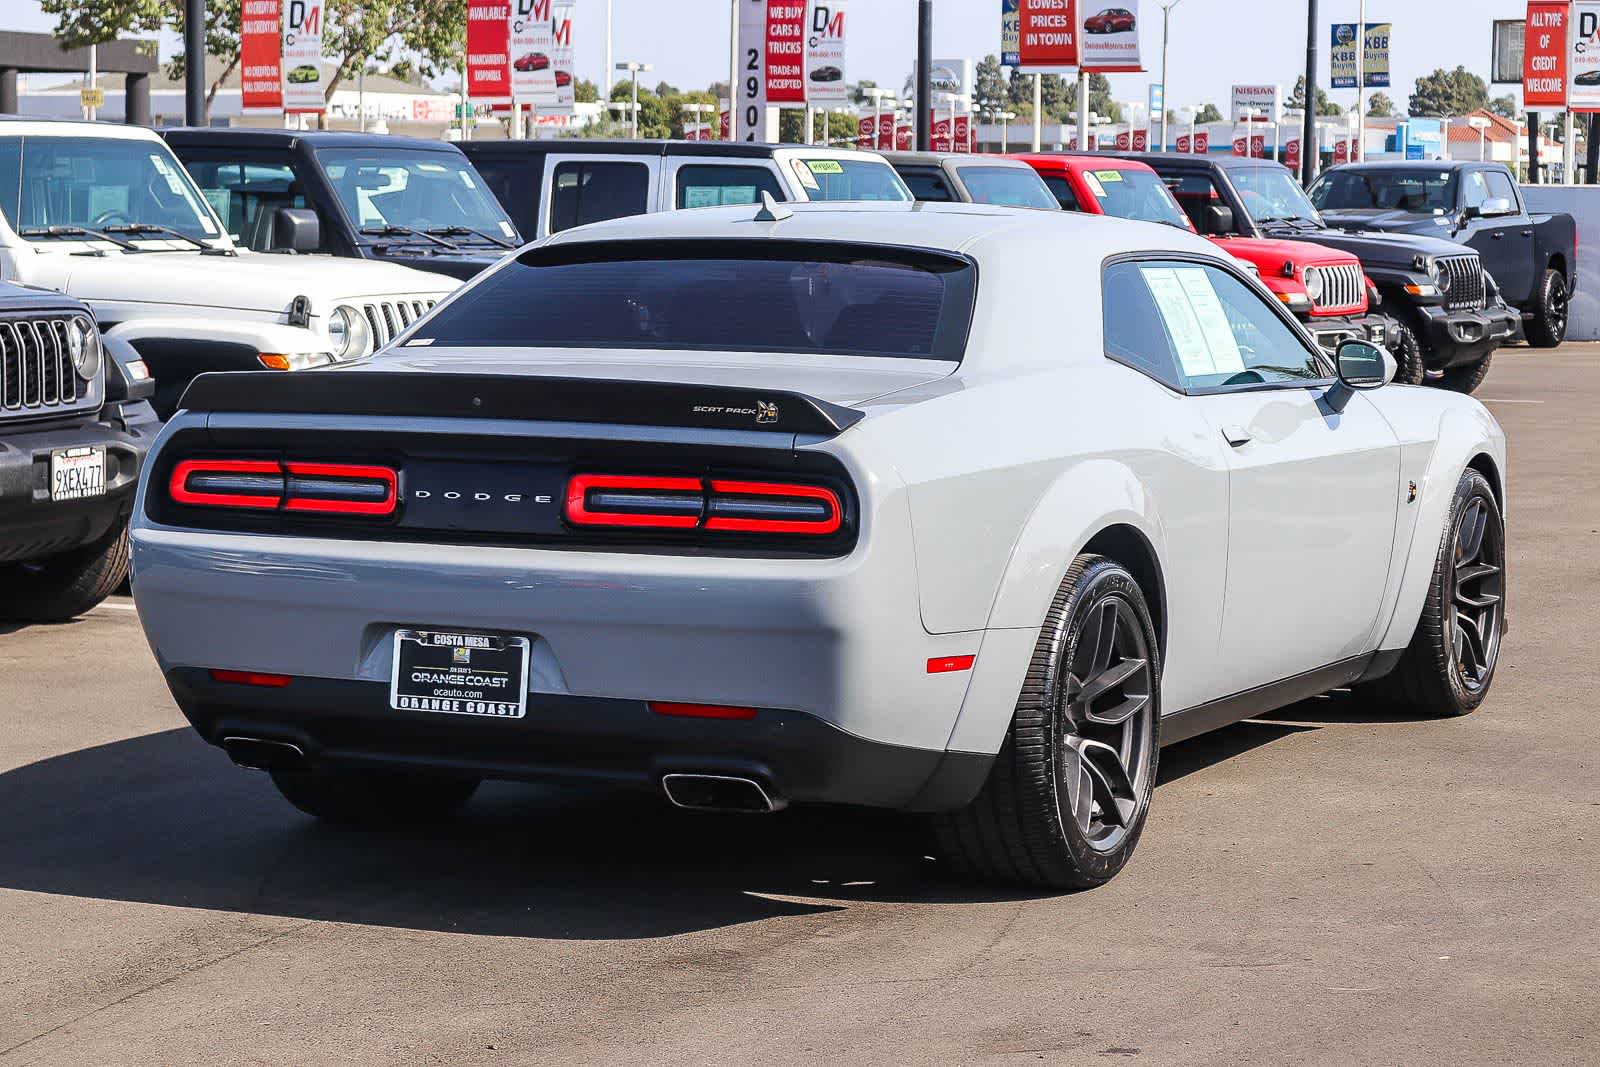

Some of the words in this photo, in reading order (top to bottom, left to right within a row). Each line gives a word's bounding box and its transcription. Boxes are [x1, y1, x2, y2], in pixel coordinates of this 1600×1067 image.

[1028, 0, 1068, 9] LOWEST
[469, 6, 507, 20] AVAILABLE
[770, 6, 784, 18] WE
[785, 6, 803, 18] BUY
[1031, 15, 1067, 27] PRICES
[1531, 12, 1544, 27] ALL
[1544, 12, 1562, 27] TYPE
[770, 24, 793, 36] CARS
[793, 24, 801, 36] &
[1027, 33, 1038, 46] IN
[1039, 33, 1072, 46] TOWN
[1364, 36, 1389, 49] KBB
[1540, 34, 1551, 48] OF
[769, 41, 801, 54] TRUCKS
[1332, 51, 1356, 62] KBB
[1364, 51, 1389, 61] Buying
[1532, 55, 1557, 71] CREDIT
[769, 65, 800, 75] TRADE-IN
[769, 79, 802, 89] ACCEPTED
[1527, 77, 1562, 93] WELCOME
[1235, 87, 1275, 95] NISSAN
[56, 465, 101, 493] 9XEX477
[415, 490, 552, 503] DODGE
[433, 634, 464, 646] COSTA
[464, 636, 490, 647] MESA
[411, 672, 465, 686] ORANGE
[465, 675, 509, 688] COAST
[433, 688, 483, 699] ocauto.com
[400, 697, 460, 711] ORANGE
[466, 702, 517, 716] COAST
